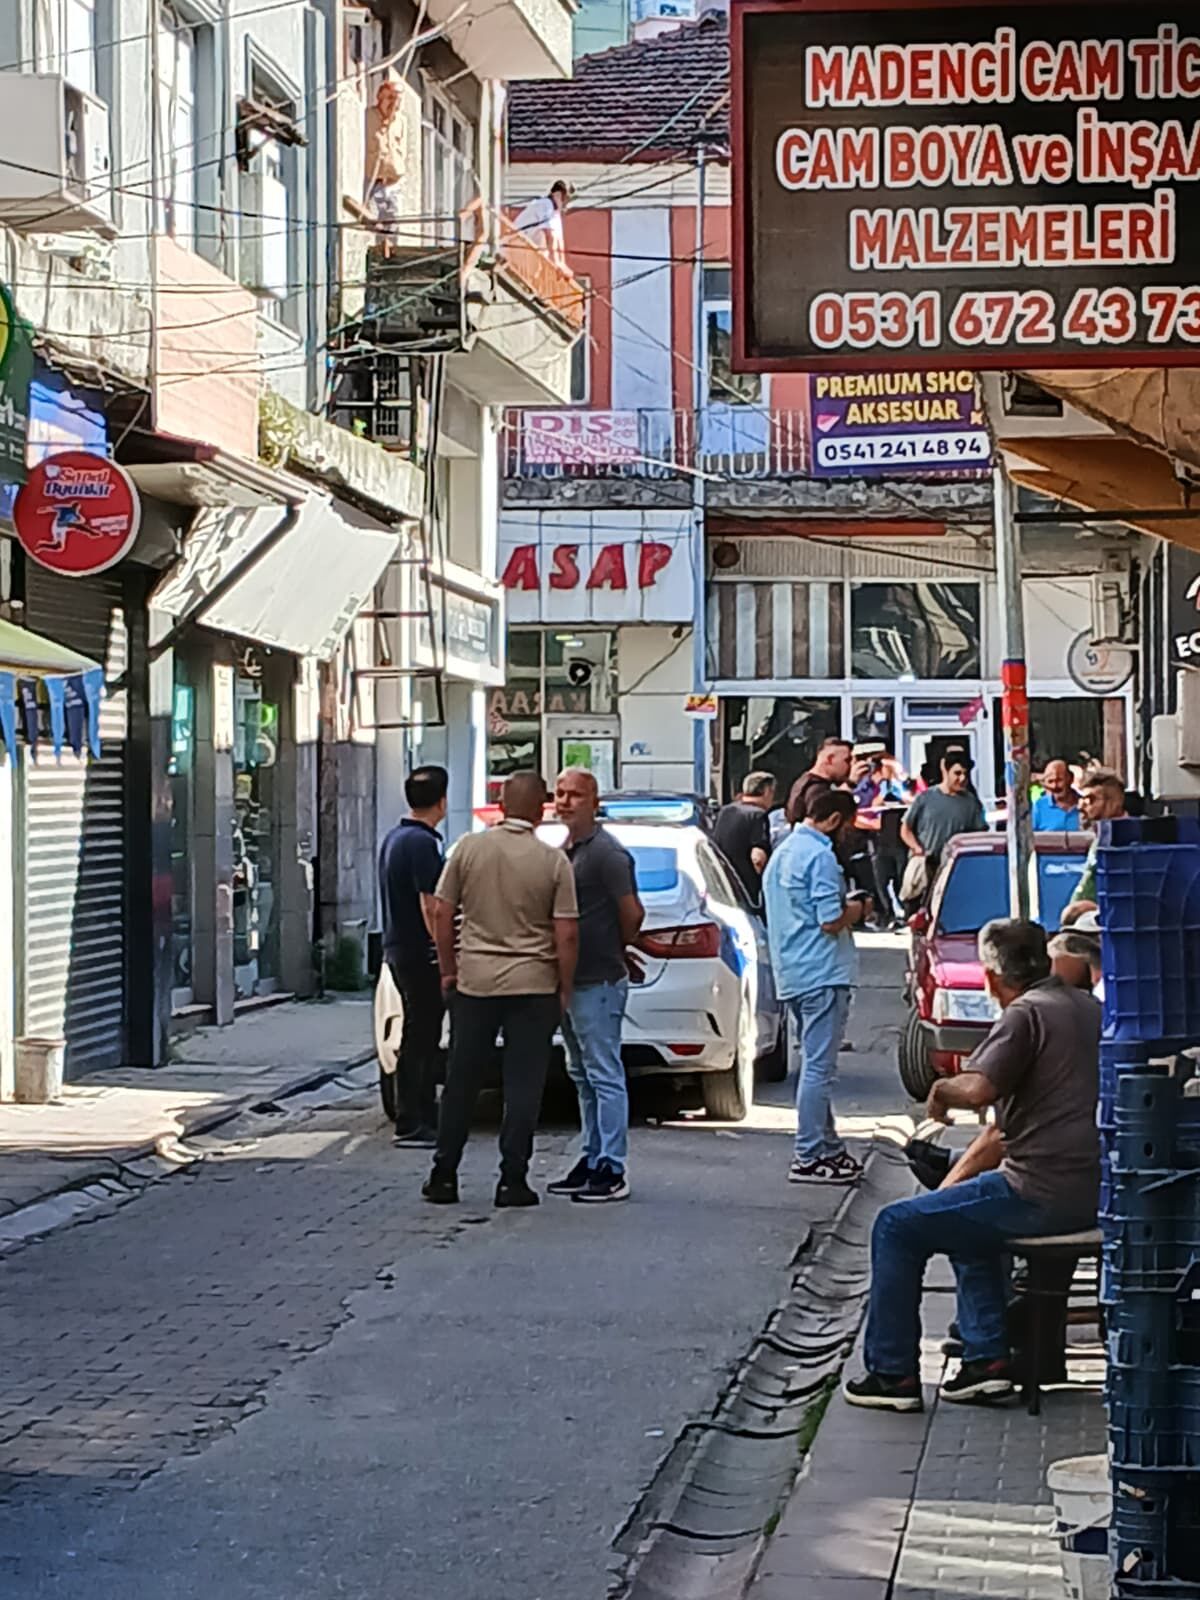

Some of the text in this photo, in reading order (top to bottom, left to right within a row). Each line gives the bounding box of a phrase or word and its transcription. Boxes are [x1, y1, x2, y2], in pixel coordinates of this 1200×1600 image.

[805, 27, 1015, 107] MADENCİ
[1020, 39, 1124, 101] CAM
[776, 127, 879, 190] CAM
[884, 124, 1012, 188] BOYA
[1013, 134, 1072, 187] ve
[850, 189, 1175, 270] MALZEMELERİ
[810, 285, 1200, 348] 0531 672 43 73
[816, 372, 922, 398] PREMIUM
[846, 399, 960, 425] AKSESUAR
[825, 437, 982, 460] 0541 241 48 94
